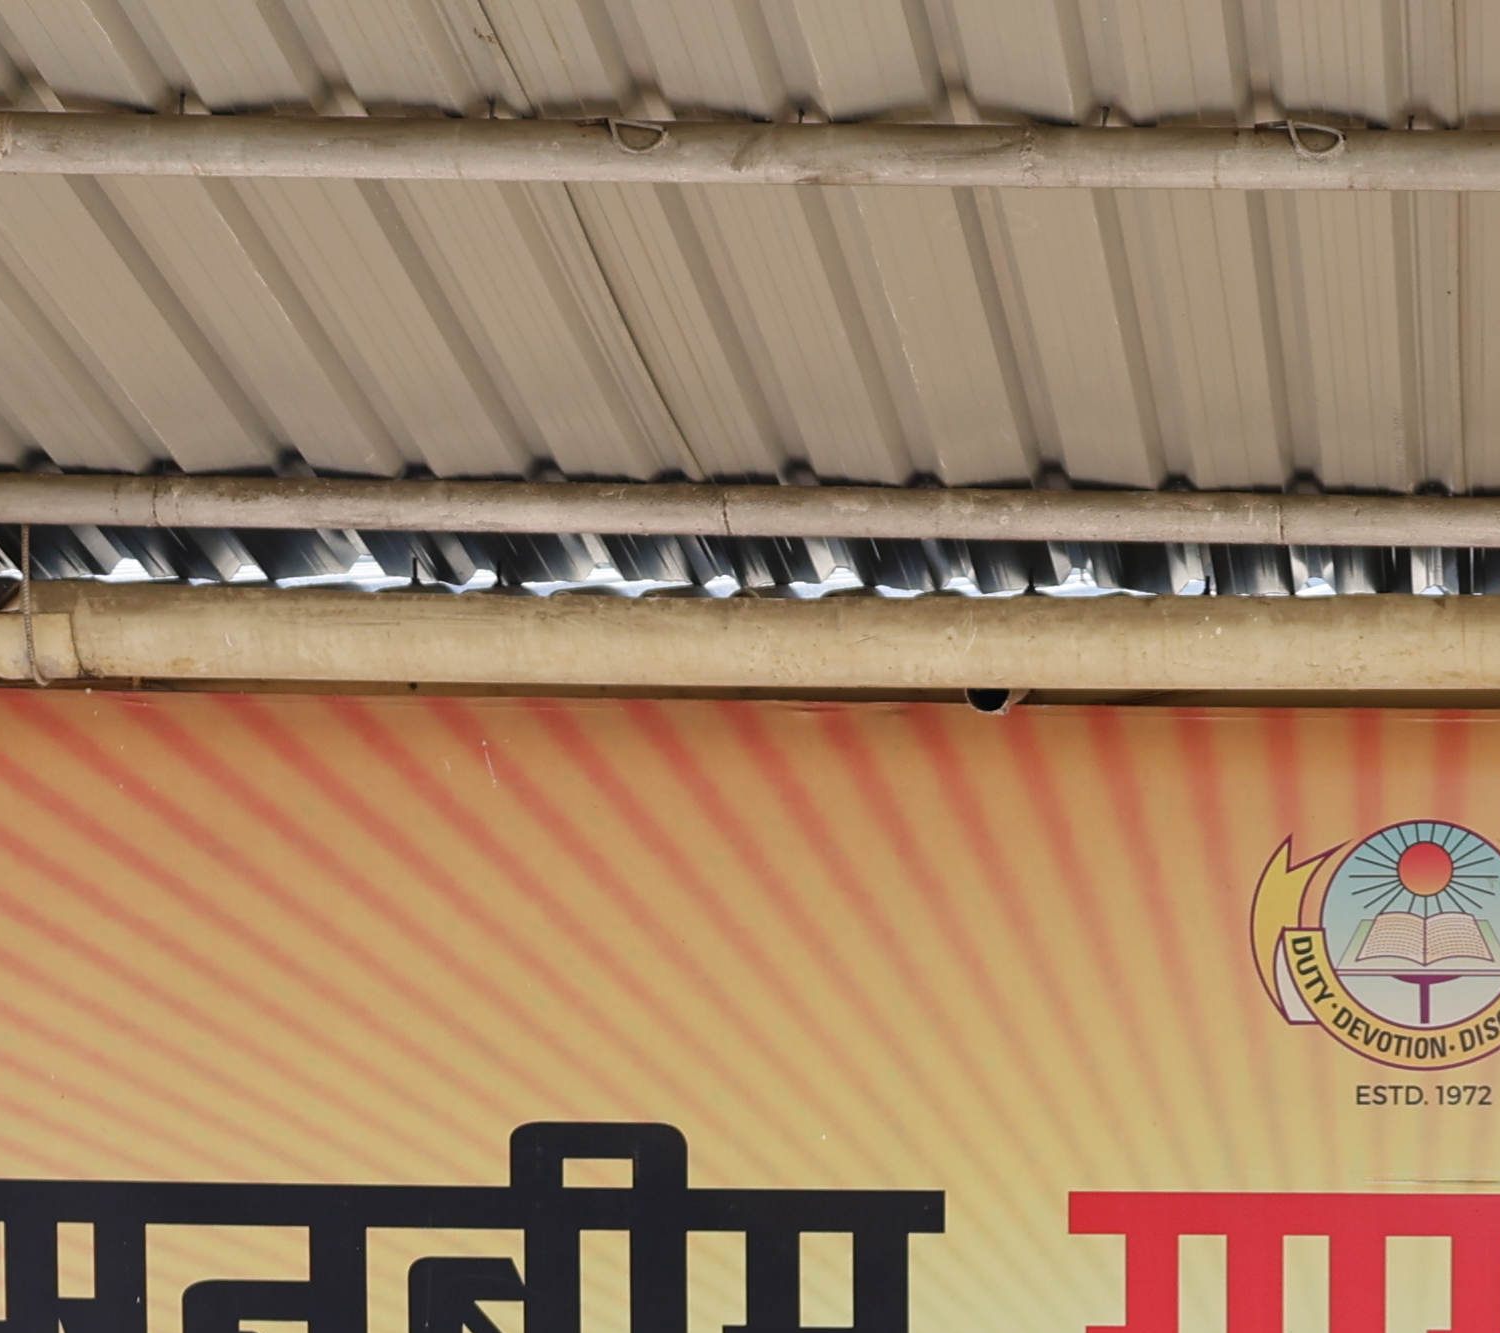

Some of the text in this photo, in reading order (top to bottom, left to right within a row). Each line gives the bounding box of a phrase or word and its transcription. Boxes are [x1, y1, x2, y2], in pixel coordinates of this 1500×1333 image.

[1291, 936, 1335, 1005] DUTY
[1332, 1006, 1447, 1059] DEVOTION
[1356, 1085, 1493, 1106] ESTD. 1972
